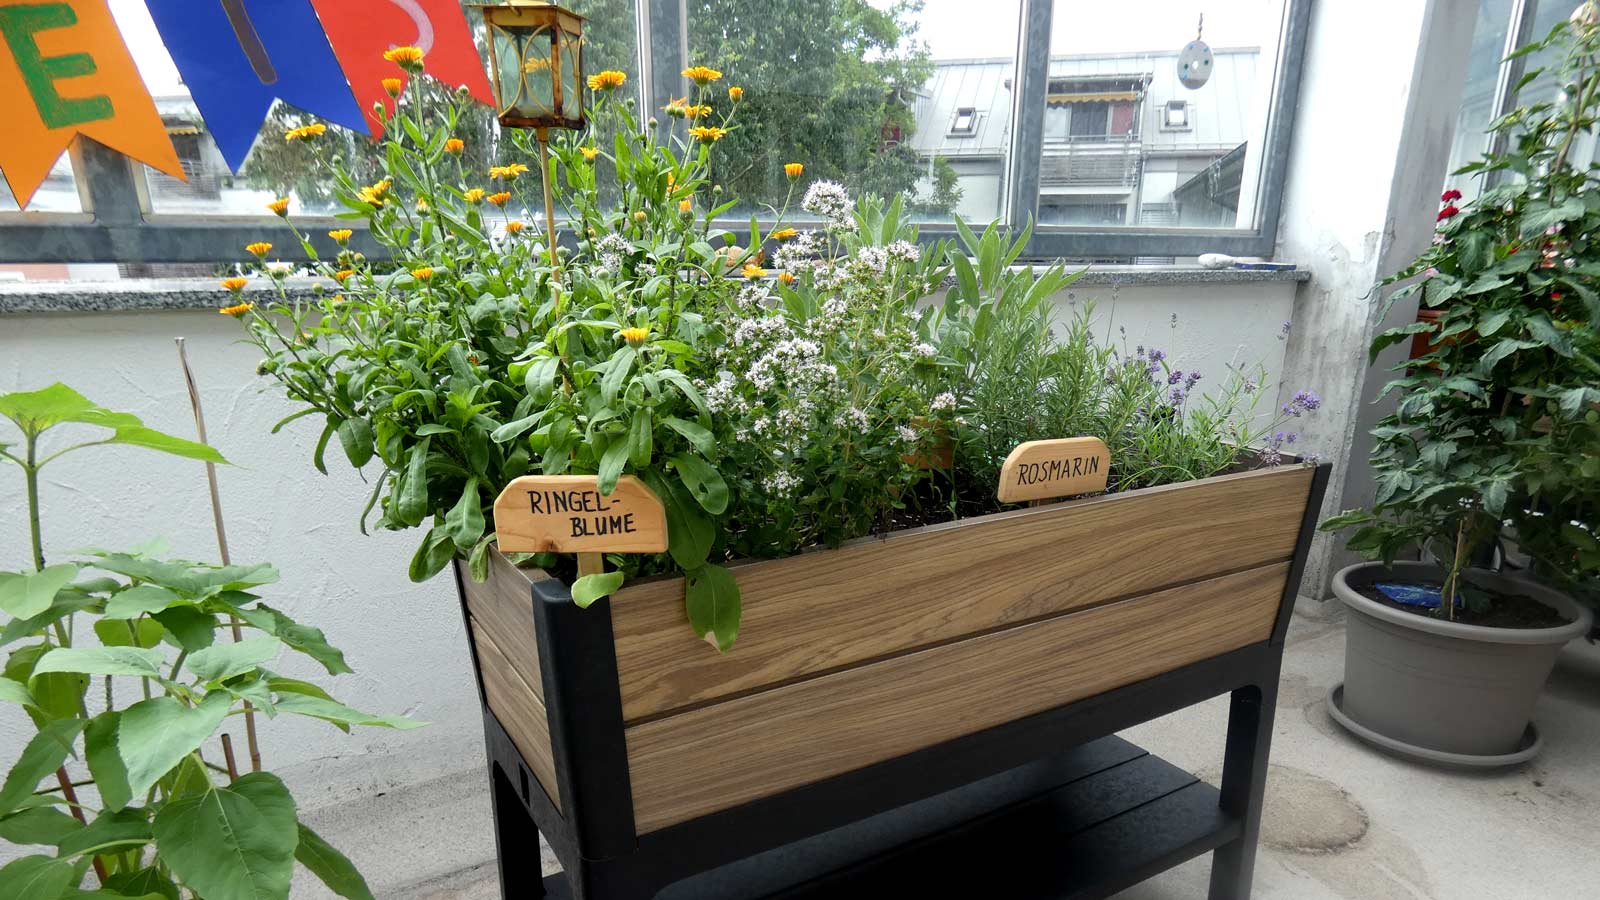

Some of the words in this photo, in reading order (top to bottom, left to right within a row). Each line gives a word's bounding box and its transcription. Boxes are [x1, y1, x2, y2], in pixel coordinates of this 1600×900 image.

[1017, 455, 1100, 486] ROSMARIN
[527, 490, 621, 515] RINGEL-
[569, 512, 637, 538] BLUME
